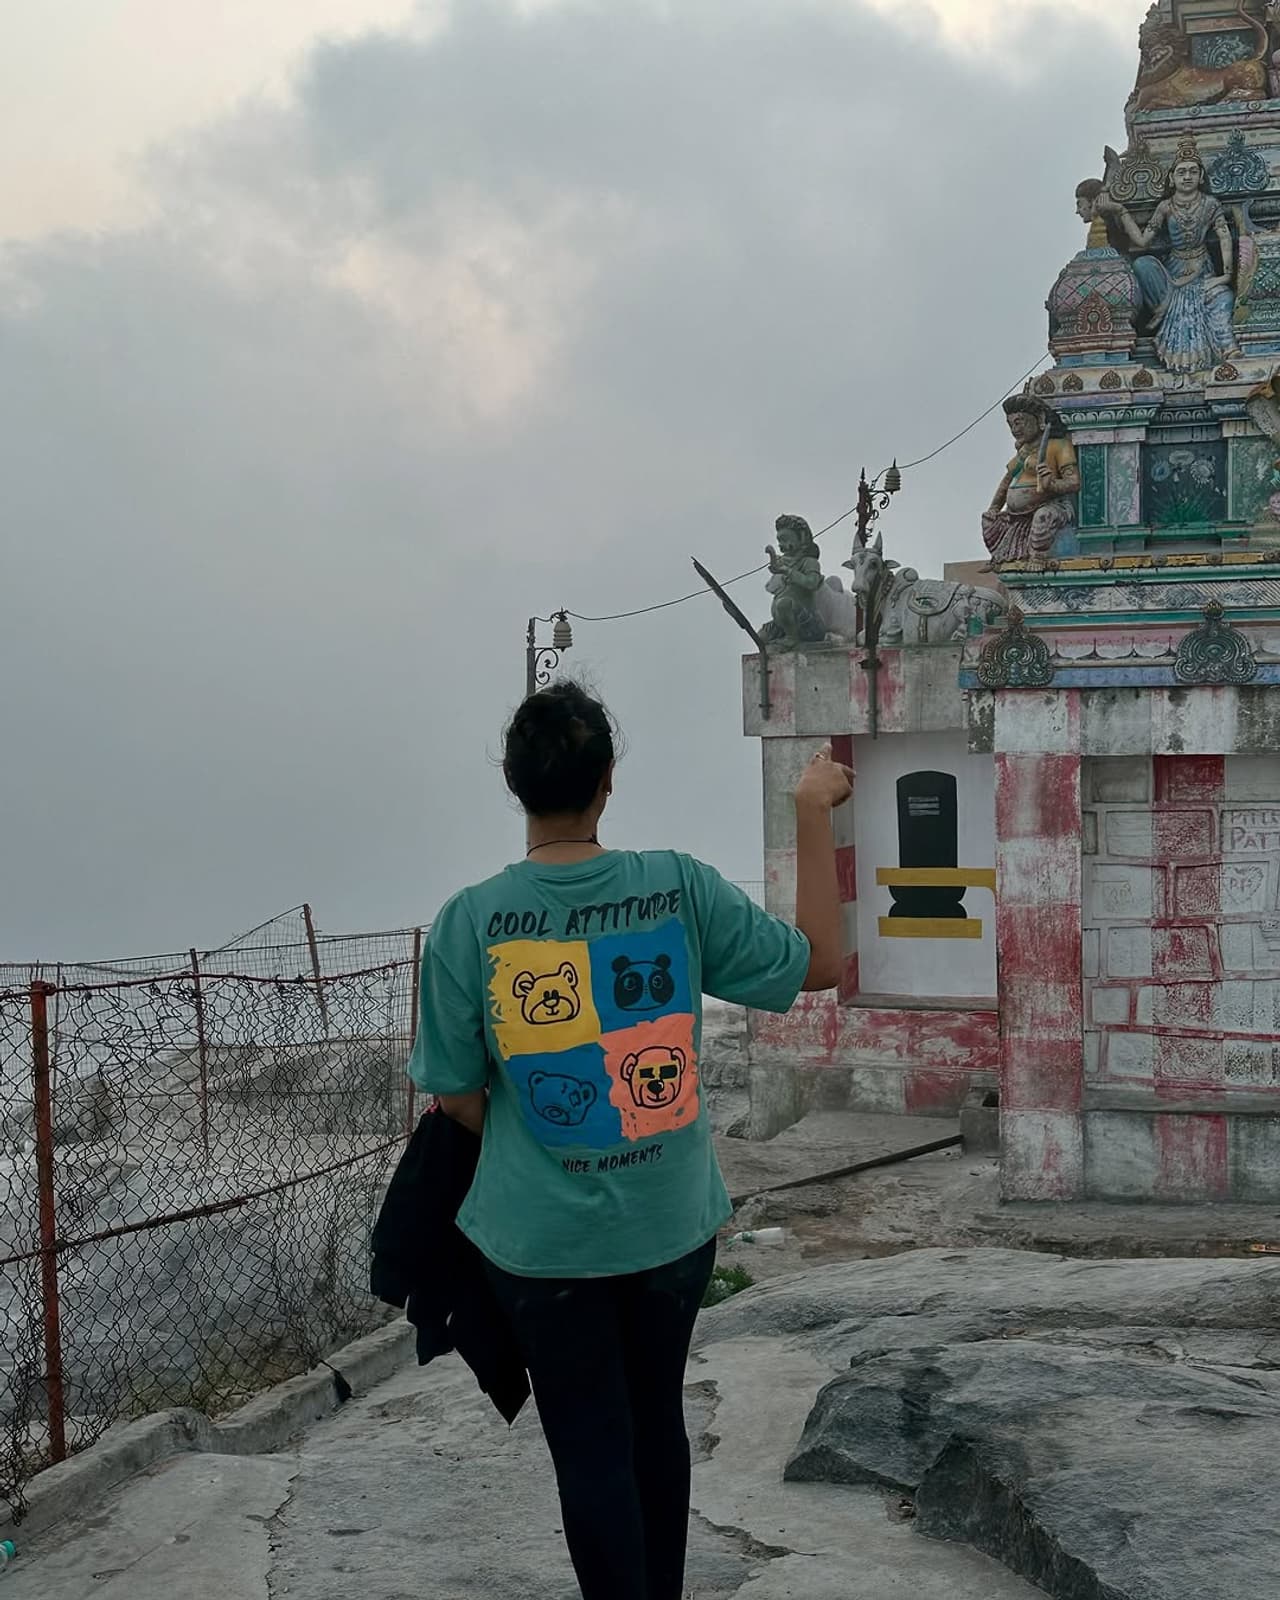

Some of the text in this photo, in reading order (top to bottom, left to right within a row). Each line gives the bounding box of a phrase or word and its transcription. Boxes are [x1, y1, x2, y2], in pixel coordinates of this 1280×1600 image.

[487, 889, 681, 938] COOL ATTITUDE
[562, 1143, 663, 1173] NICE MOMENTS
